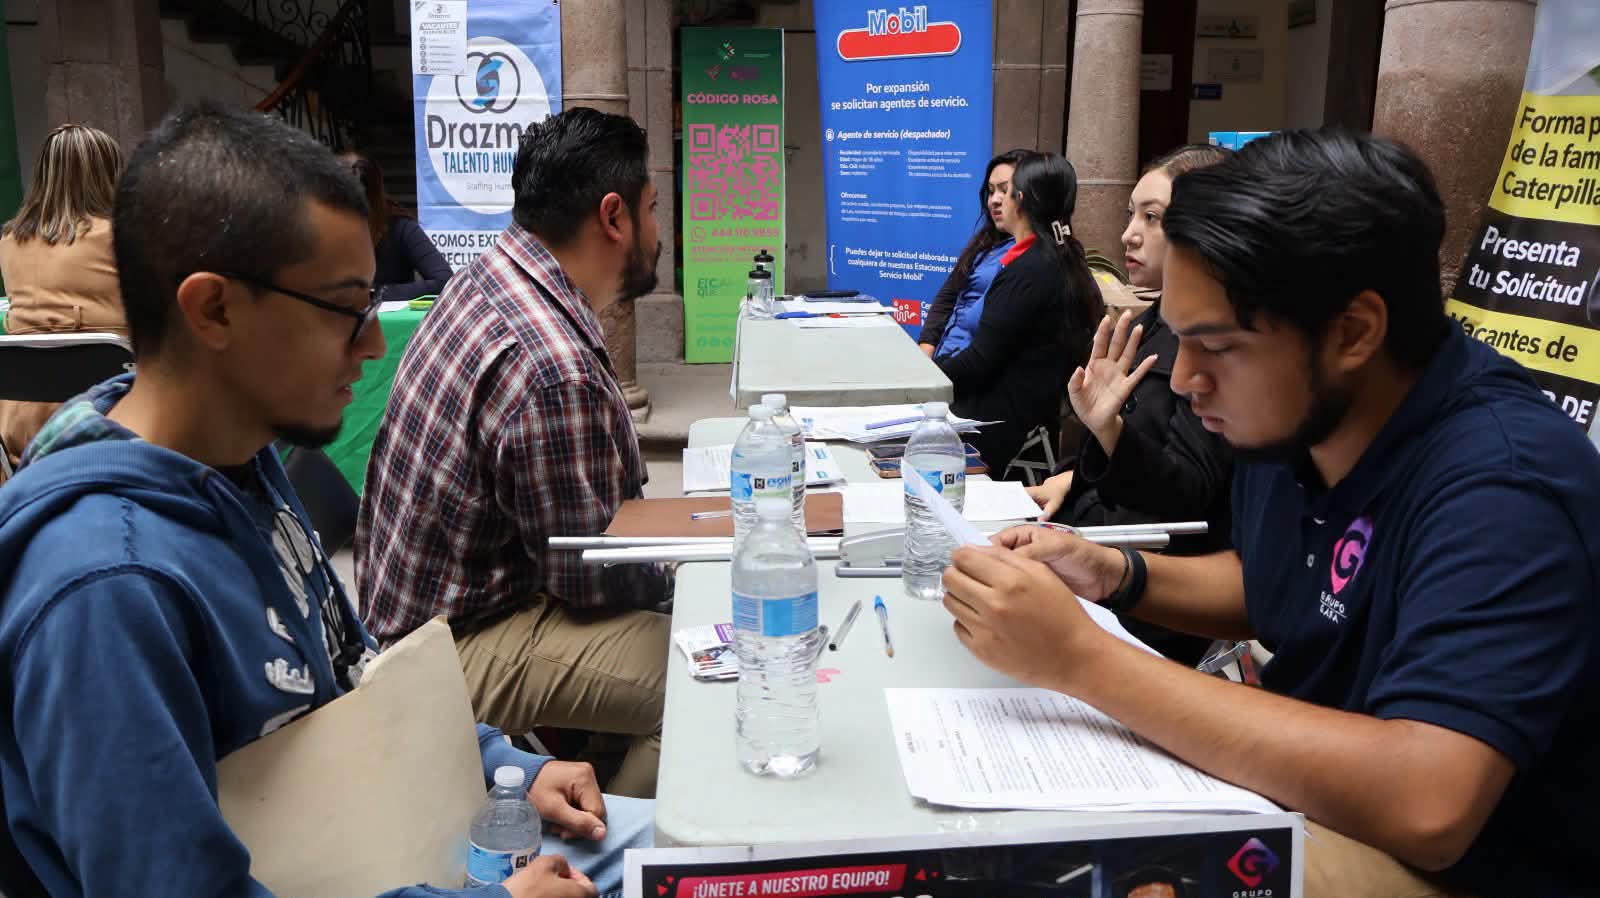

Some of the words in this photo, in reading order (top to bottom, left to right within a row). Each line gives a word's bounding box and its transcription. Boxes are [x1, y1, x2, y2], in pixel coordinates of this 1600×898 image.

[867, 5, 928, 37] Mobil
[687, 91, 740, 105] CÓDIGO
[743, 93, 779, 105] ROSA
[866, 83, 882, 94] Por
[884, 80, 930, 96] expansión
[831, 101, 841, 110] se
[842, 98, 878, 110] solicitan
[880, 98, 916, 112] agentes
[918, 96, 929, 108] de
[931, 95, 969, 108] servicio.
[427, 114, 549, 149] Drazm
[1520, 105, 1586, 135] Forma
[837, 130, 862, 141] Agente
[863, 129, 872, 139] de
[873, 129, 899, 139] servicio
[900, 129, 951, 141] (despachador)
[442, 151, 489, 174] TALENTO
[1511, 138, 1537, 165] de
[1539, 141, 1558, 168] la
[1502, 170, 1600, 209] Caterpilla
[431, 233, 475, 248] SOMOS
[1480, 225, 1581, 268] Presenta
[845, 247, 868, 257] Puedes
[868, 248, 883, 259] dejar
[884, 250, 892, 258] tu
[892, 250, 918, 260] solicitud
[919, 251, 949, 262] elaborada
[847, 258, 878, 268] cualquiera
[878, 259, 887, 267] de
[887, 260, 913, 270] nuestras
[914, 261, 947, 273] Estaciones
[879, 270, 902, 280] Servicio
[1468, 263, 1491, 290] tu
[1545, 335, 1579, 363] de
[1561, 394, 1593, 425] DE
[1320, 591, 1345, 614] GRUPO
[693, 879, 745, 898] ¡ÚNETE
[747, 883, 757, 895] A
[761, 874, 828, 894] NUESTRO
[831, 870, 891, 890] EQUIPO!
[1232, 888, 1273, 898] GRUPO
